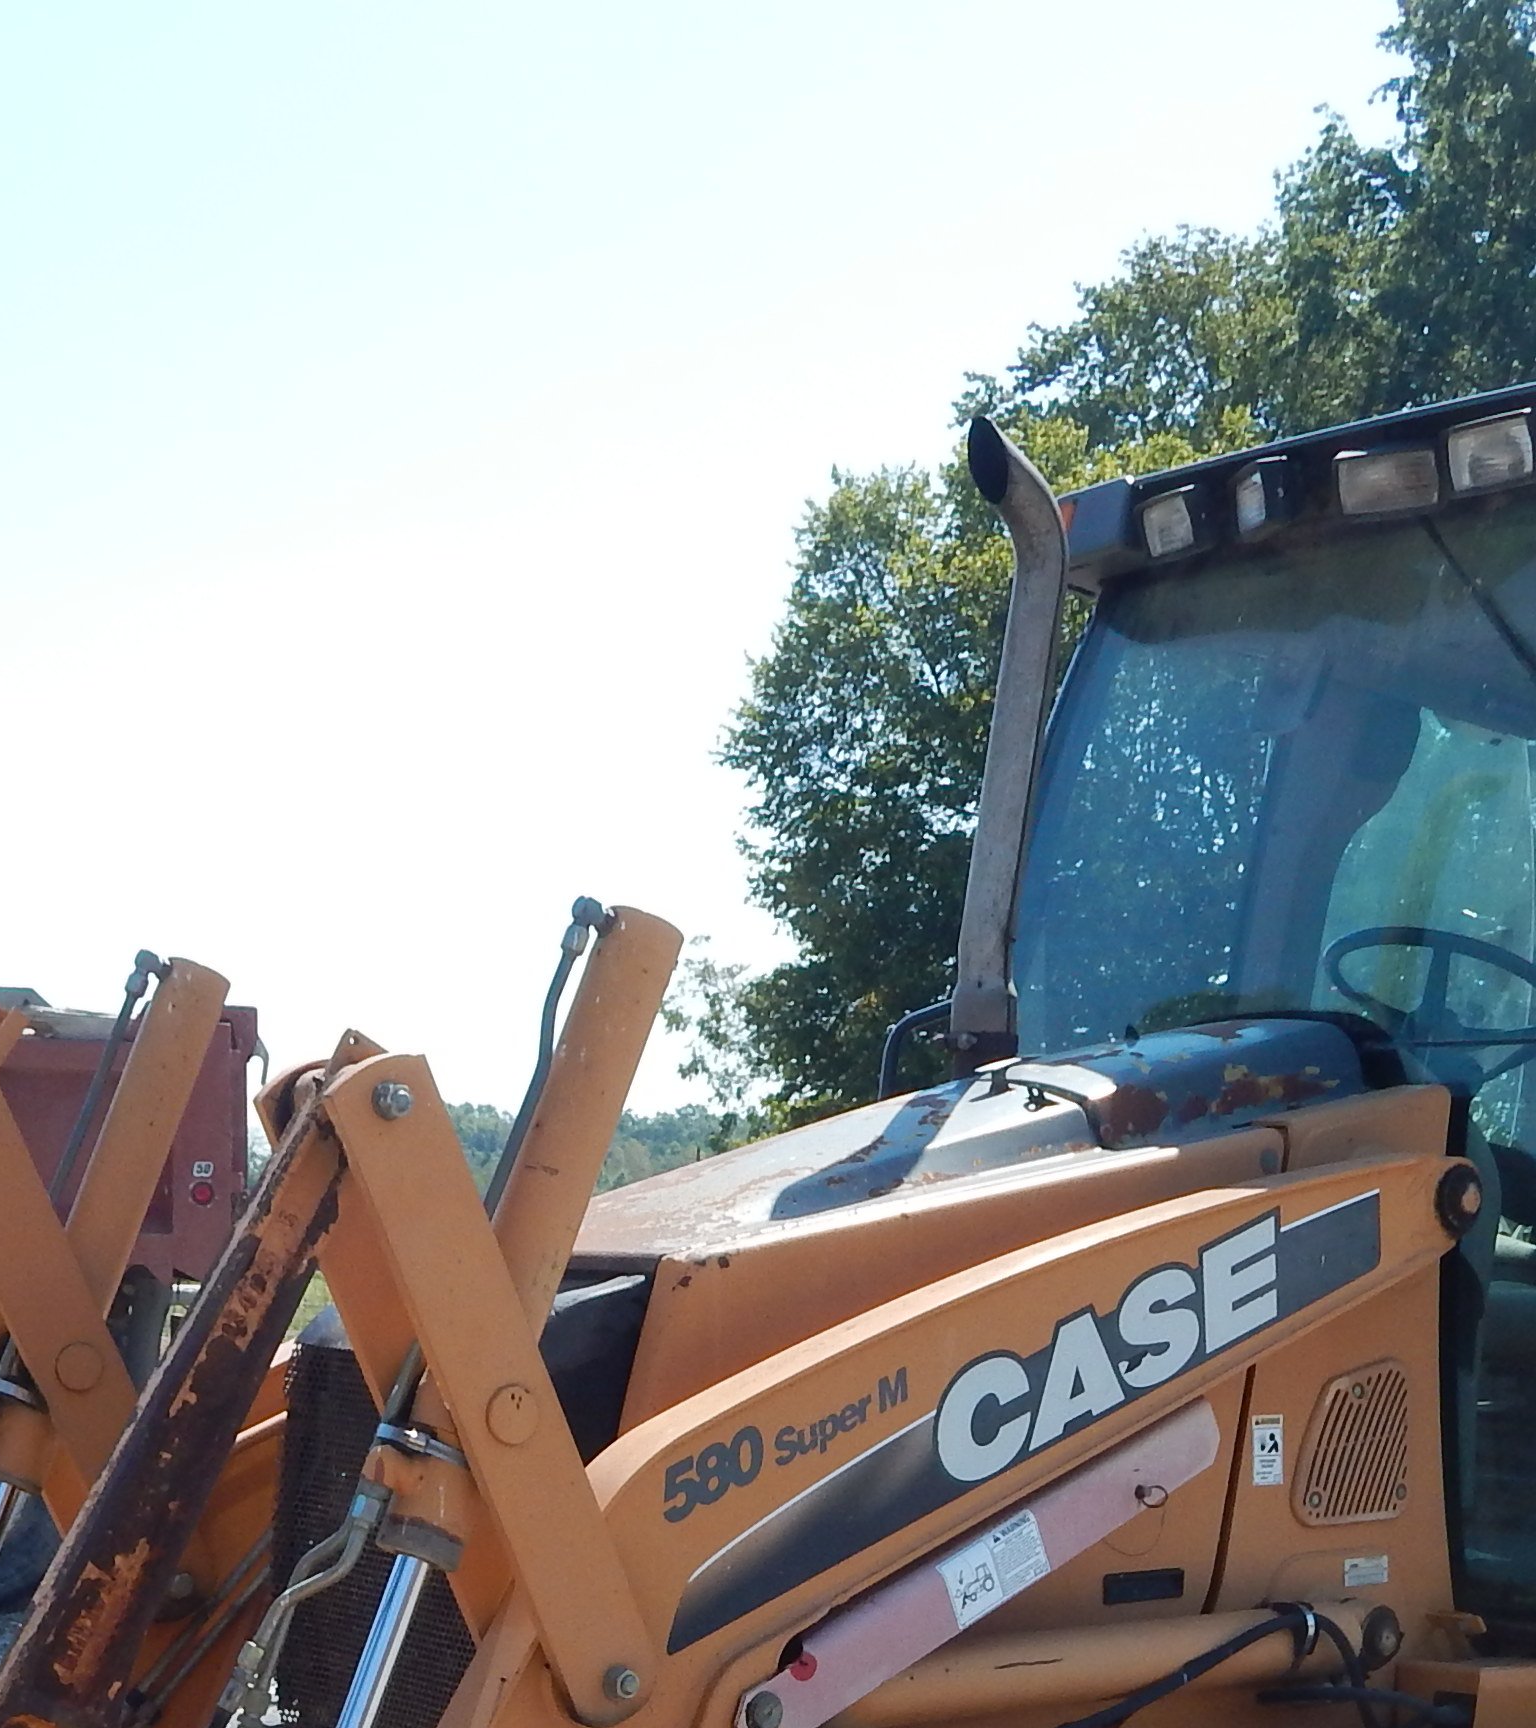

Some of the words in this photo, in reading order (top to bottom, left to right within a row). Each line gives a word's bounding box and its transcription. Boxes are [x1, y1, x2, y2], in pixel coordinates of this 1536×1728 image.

[663, 1425, 763, 1523] 580
[774, 1394, 872, 1466] Super
[878, 1366, 908, 1413] M
[938, 1215, 1278, 1482] CASE
